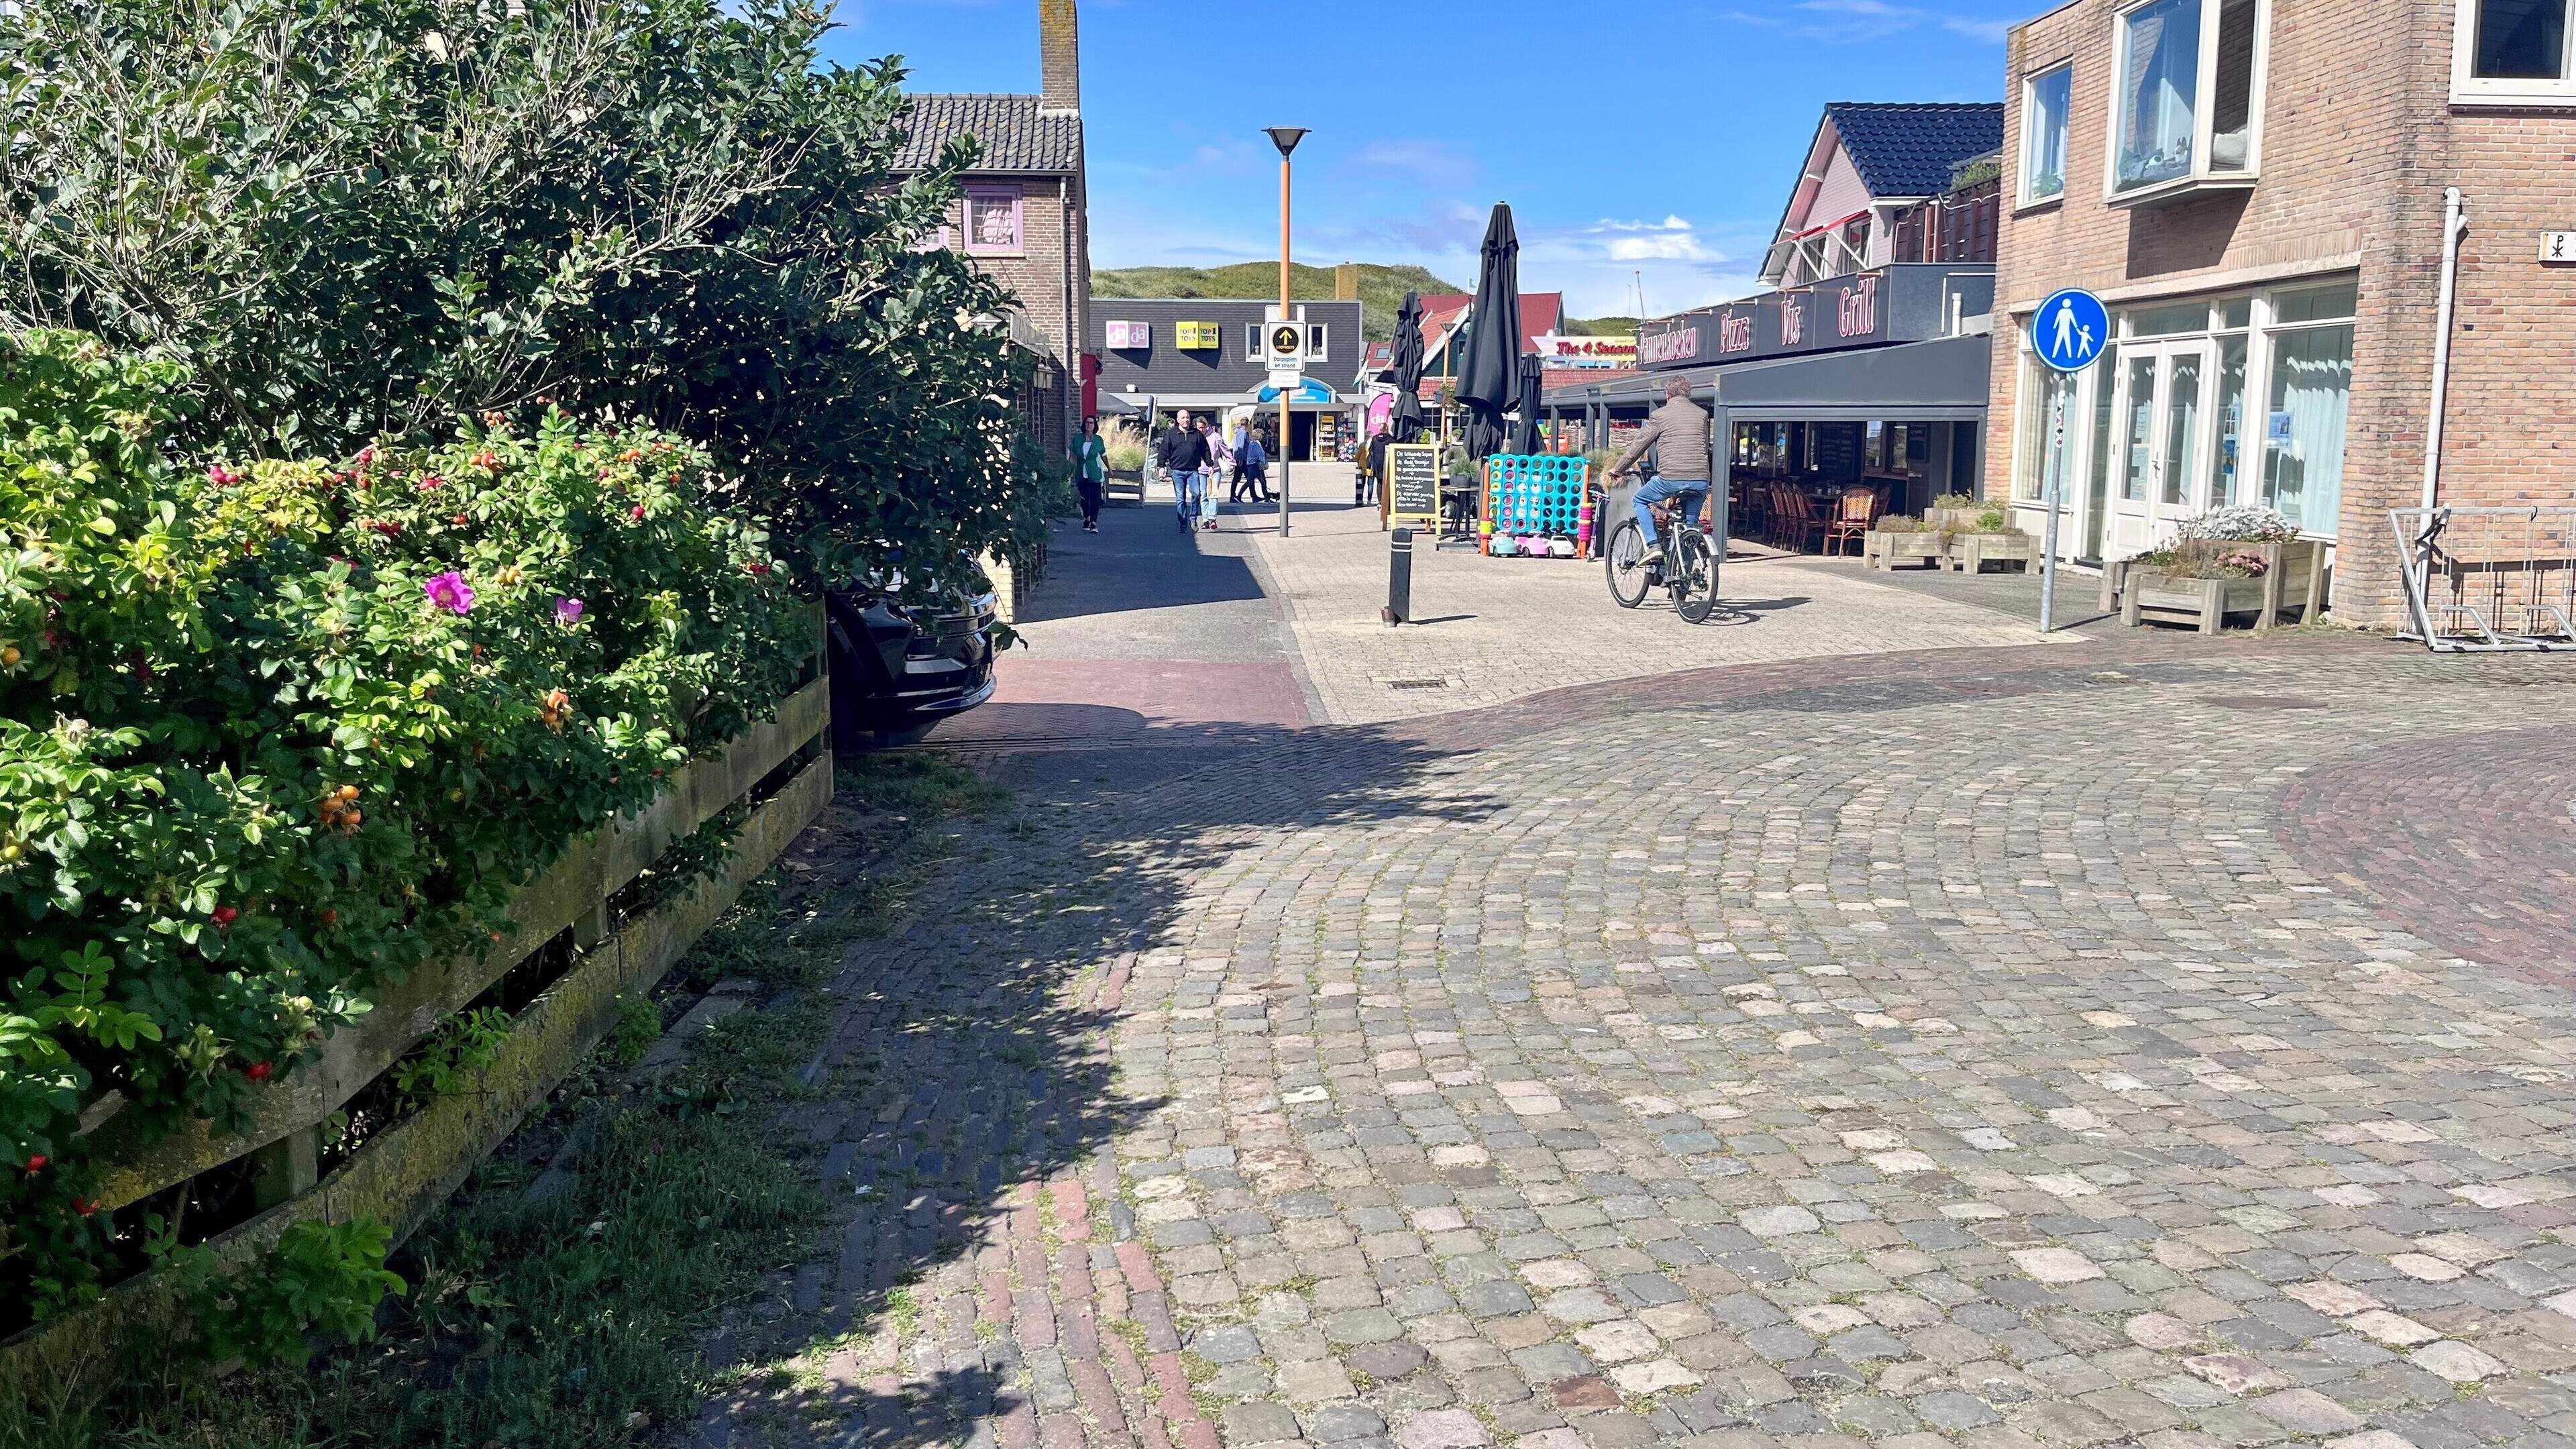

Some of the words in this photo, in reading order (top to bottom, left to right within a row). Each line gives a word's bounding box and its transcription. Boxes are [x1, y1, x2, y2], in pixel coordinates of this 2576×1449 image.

[1639, 320, 1696, 364] Pannenkoeken
[1720, 309, 1750, 353] Pizza
[1781, 295, 1801, 345] Vis
[1838, 277, 1875, 337] Grill
[1131, 327, 1146, 342] da
[1556, 341, 1580, 356] The
[1582, 341, 1593, 356] 4
[1594, 341, 1638, 356] Season
[1371, 413, 1385, 424] da
